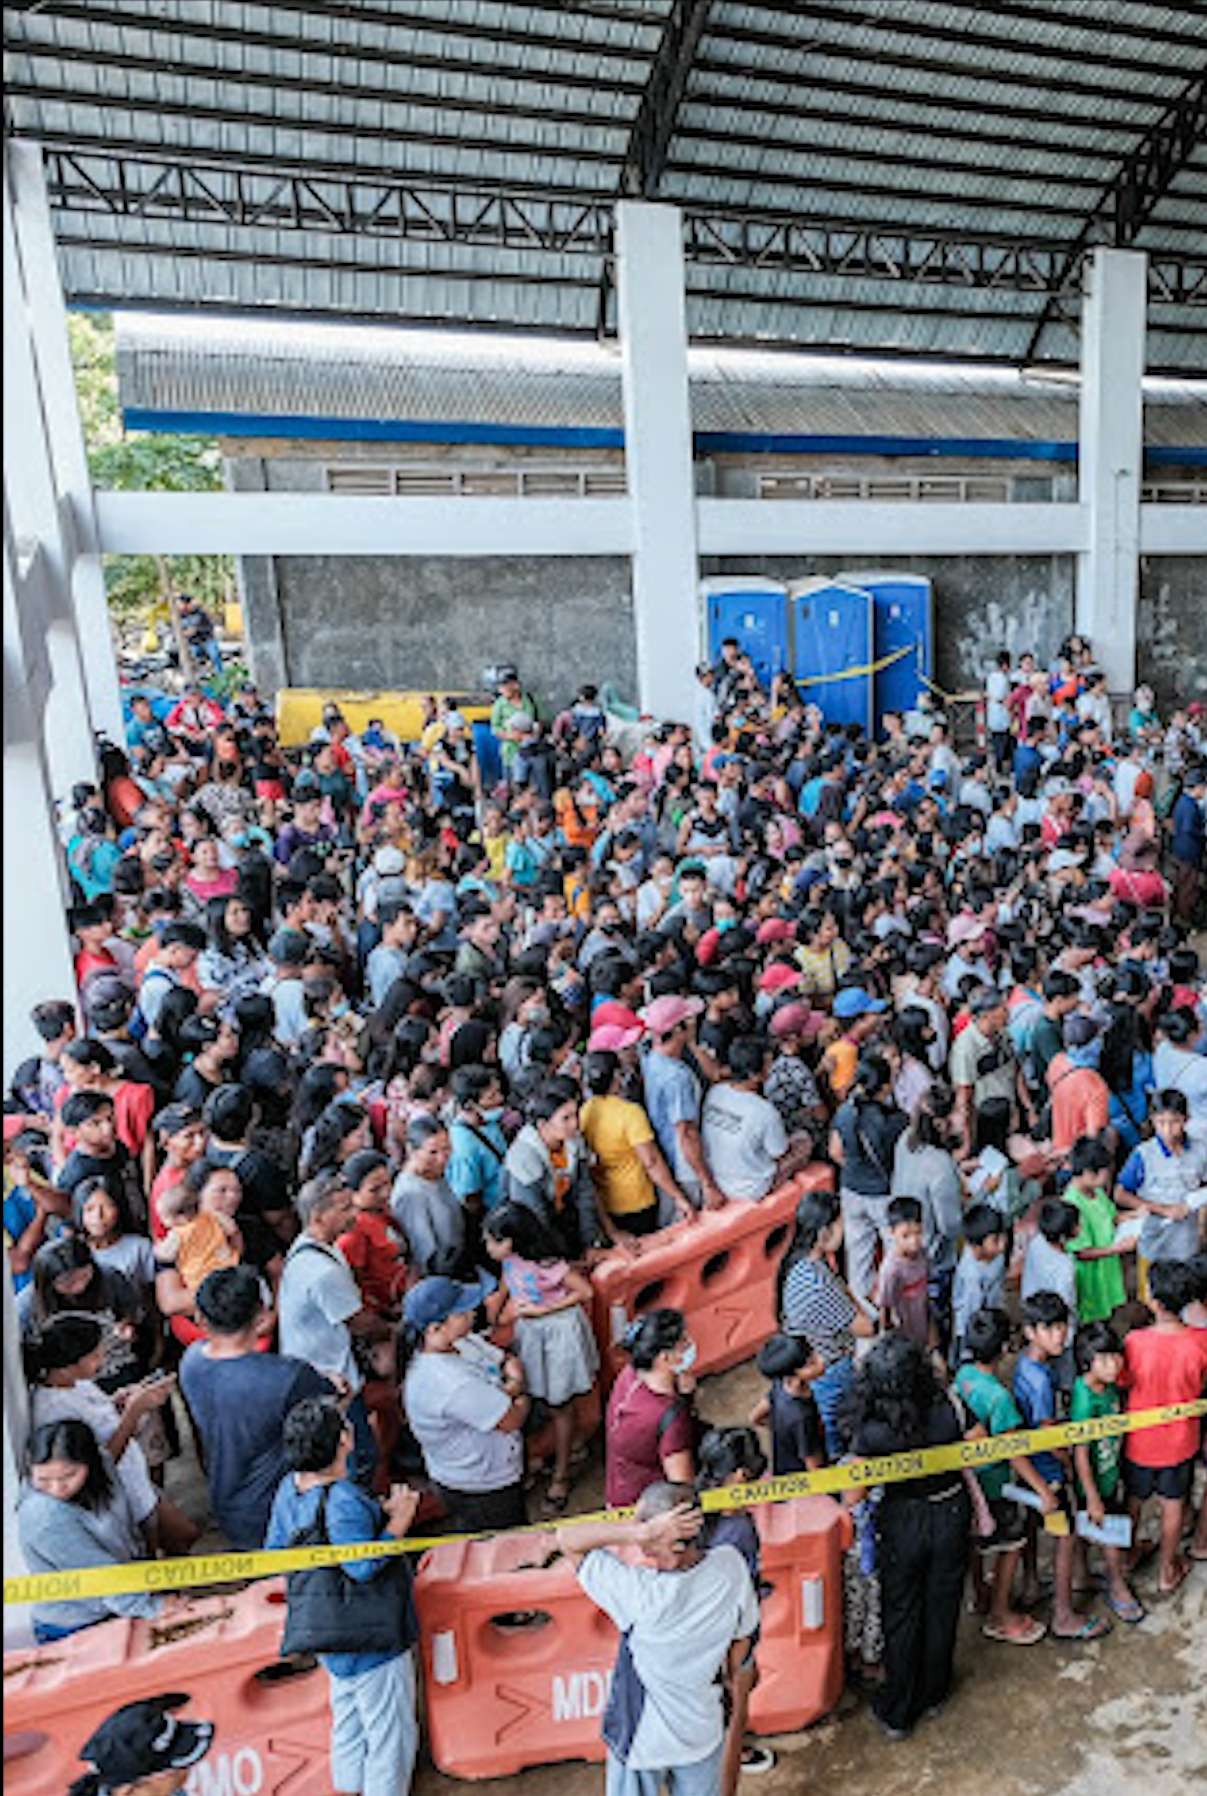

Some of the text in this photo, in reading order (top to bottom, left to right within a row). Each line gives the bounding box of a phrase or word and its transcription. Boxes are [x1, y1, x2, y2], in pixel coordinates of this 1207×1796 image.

[729, 1477, 811, 1501] CAUTION
[849, 1453, 924, 1482] CAUTION
[961, 1434, 1031, 1462] CAUTION
[1064, 1414, 1130, 1440] CAUTION
[186, 1747, 263, 1796] MO
